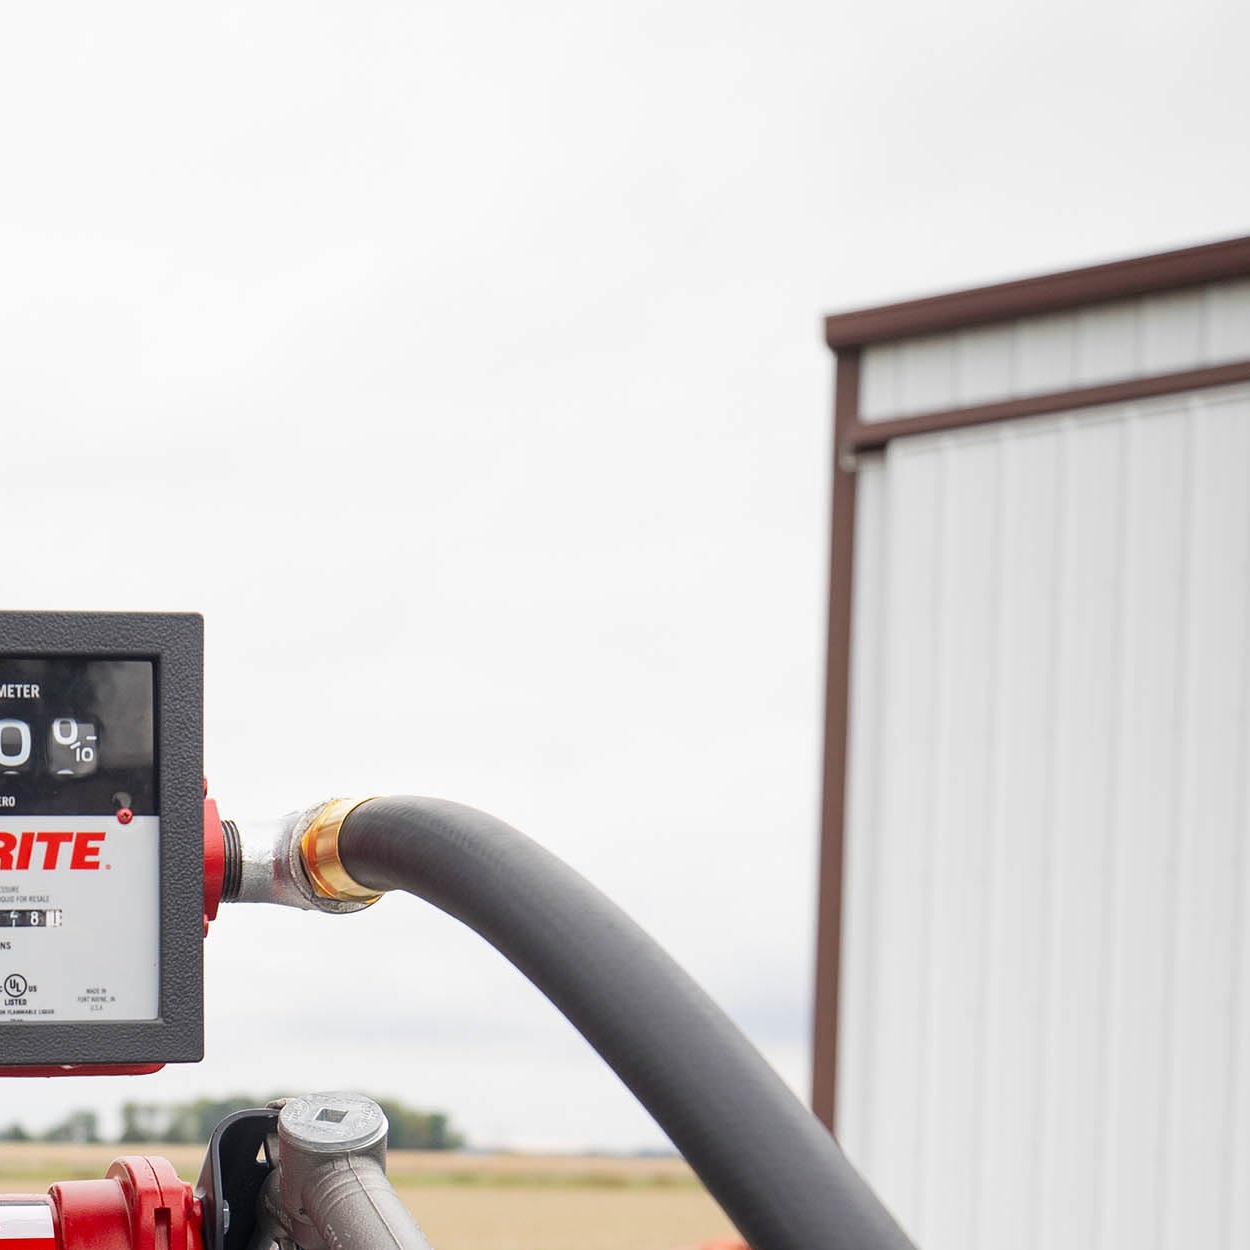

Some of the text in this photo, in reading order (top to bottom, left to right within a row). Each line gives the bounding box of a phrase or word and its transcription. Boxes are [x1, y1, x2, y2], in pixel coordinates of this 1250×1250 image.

[16, 895, 28, 903] FOR
[29, 895, 50, 903] RESALE
[4, 998, 27, 1006] LISTED
